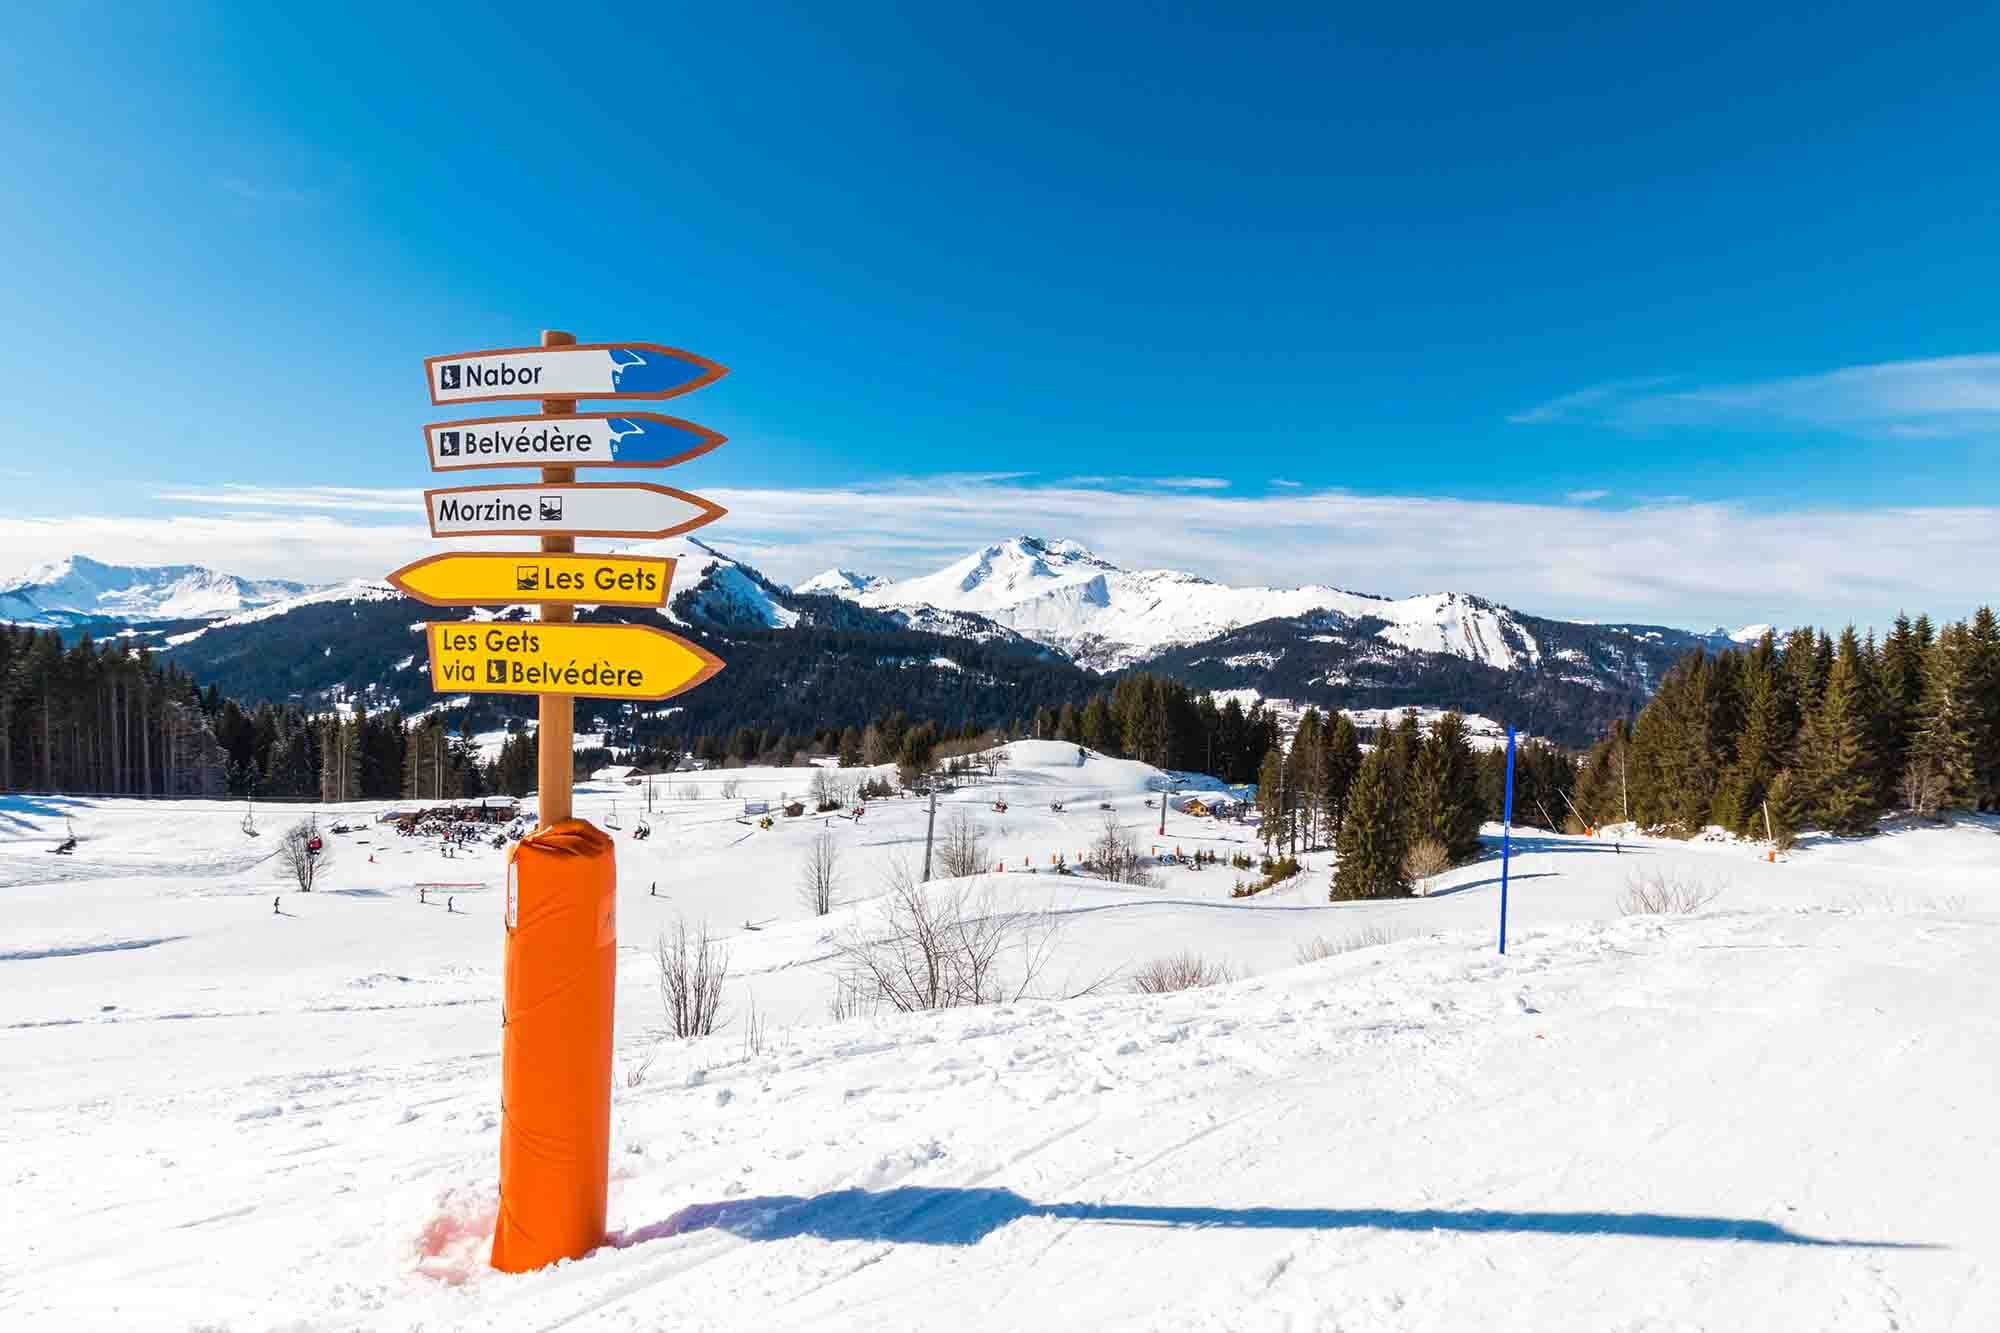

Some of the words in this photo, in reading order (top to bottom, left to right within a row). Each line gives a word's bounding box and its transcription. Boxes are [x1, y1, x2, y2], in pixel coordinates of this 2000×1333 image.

[466, 362, 543, 387] Nabor
[465, 427, 592, 455] Belvédère
[439, 498, 532, 522] Morzine
[545, 567, 585, 590] Les
[594, 567, 657, 591] Gets
[443, 628, 477, 652] Les
[486, 629, 540, 653] Gets
[443, 660, 475, 682] via
[511, 660, 643, 687] Belvédère
